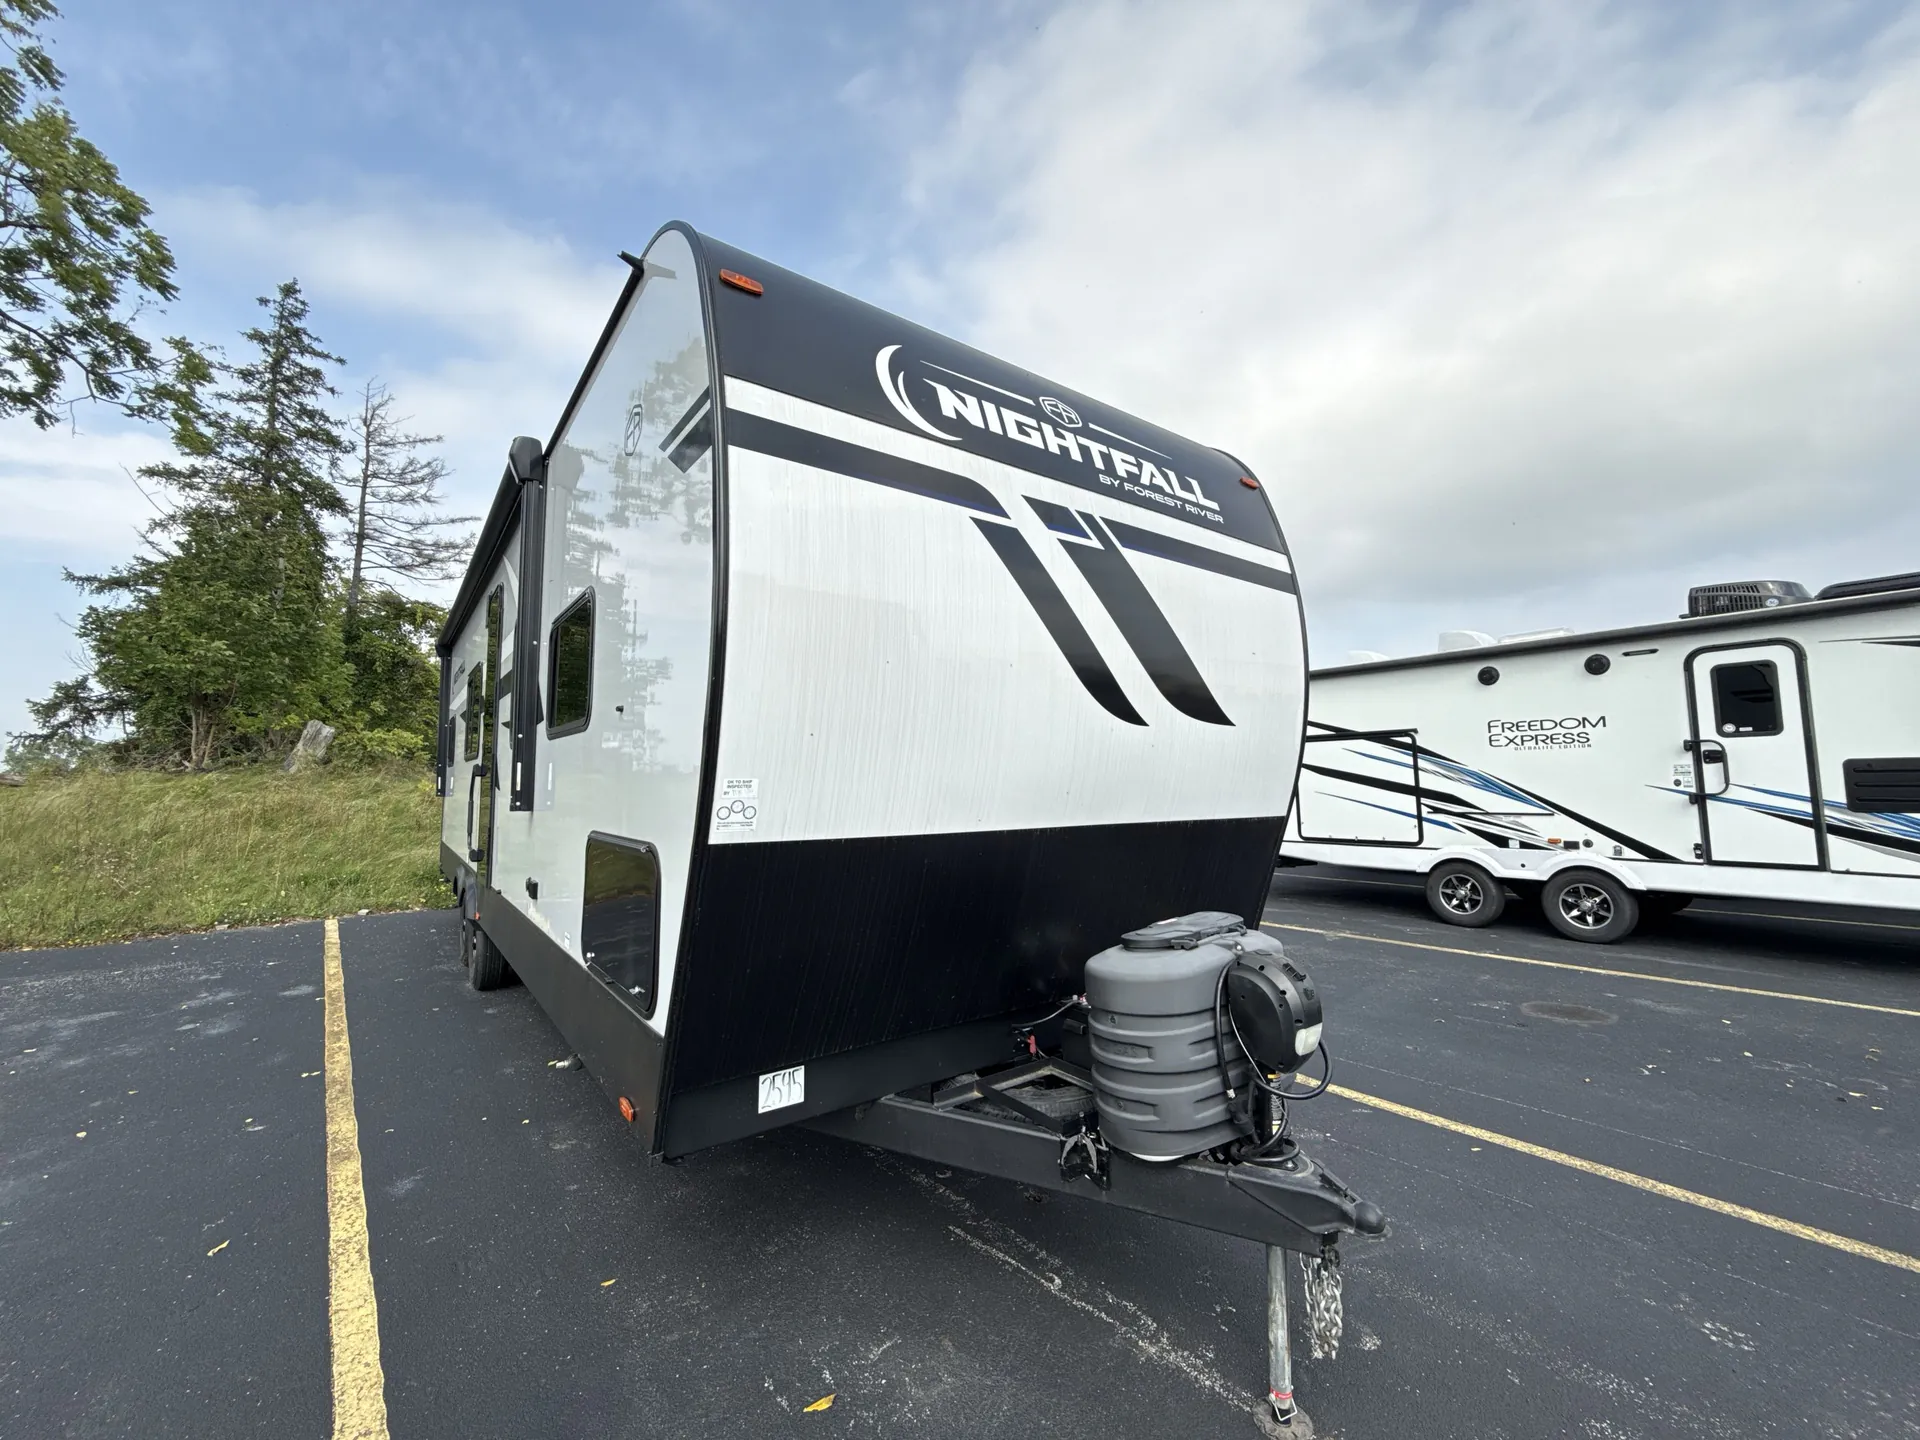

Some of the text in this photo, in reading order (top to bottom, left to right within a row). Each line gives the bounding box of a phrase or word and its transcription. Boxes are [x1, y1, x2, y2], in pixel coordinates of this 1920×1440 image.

[923, 378, 1220, 511] NIGHTFALL
[1098, 473, 1224, 524] BY FOREST RIVER
[1487, 715, 1607, 733] FREEDOM
[1488, 732, 1590, 747] EXPRESS
[761, 1067, 803, 1109] 2595
